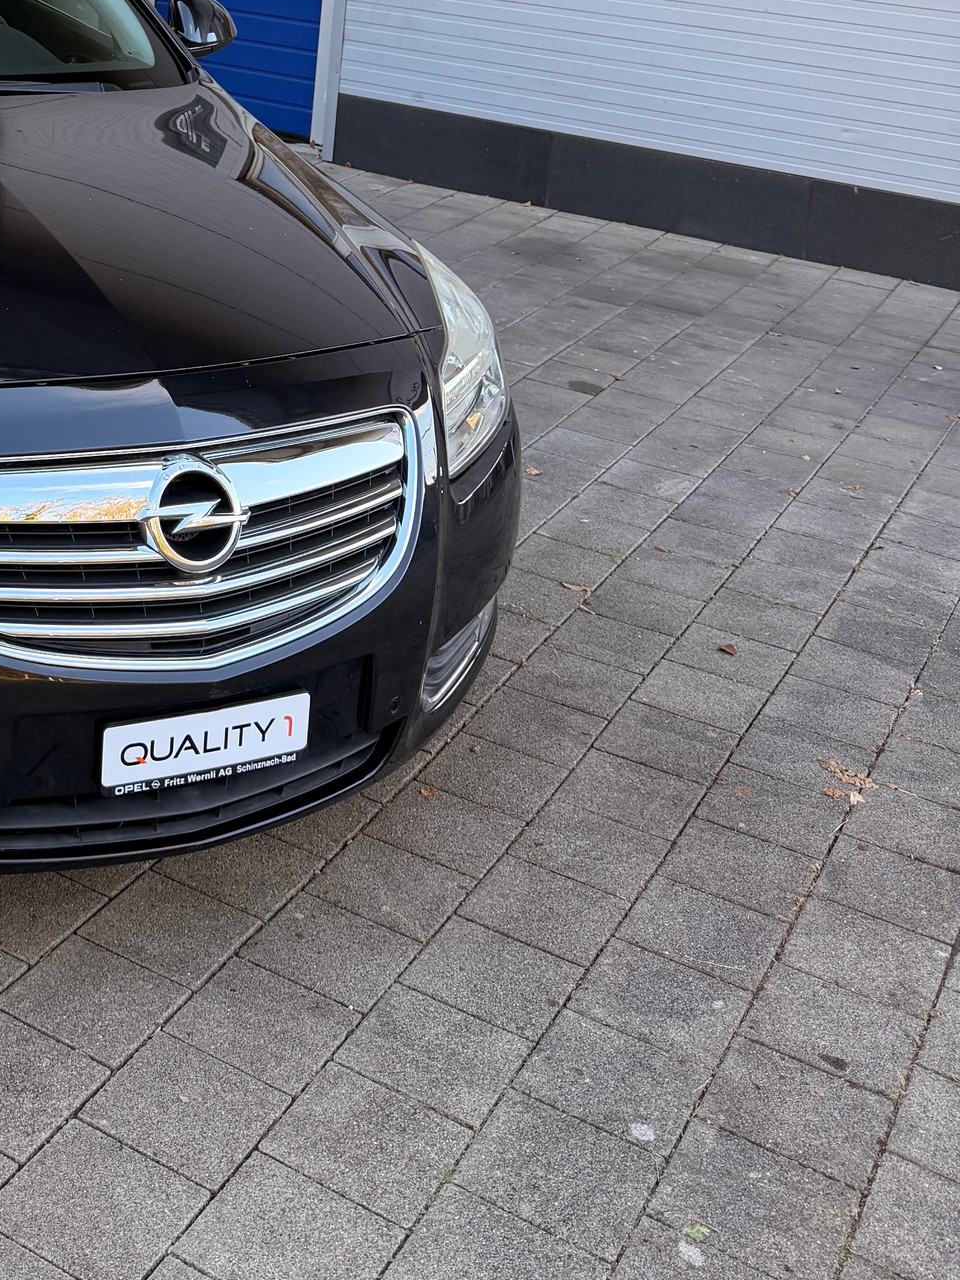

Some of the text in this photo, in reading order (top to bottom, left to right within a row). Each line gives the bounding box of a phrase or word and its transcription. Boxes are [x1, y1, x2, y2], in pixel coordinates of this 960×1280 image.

[120, 715, 293, 767] QUALITY 1
[114, 753, 297, 796] OPEL Fritz Wernli AG Schinznach-Bad
